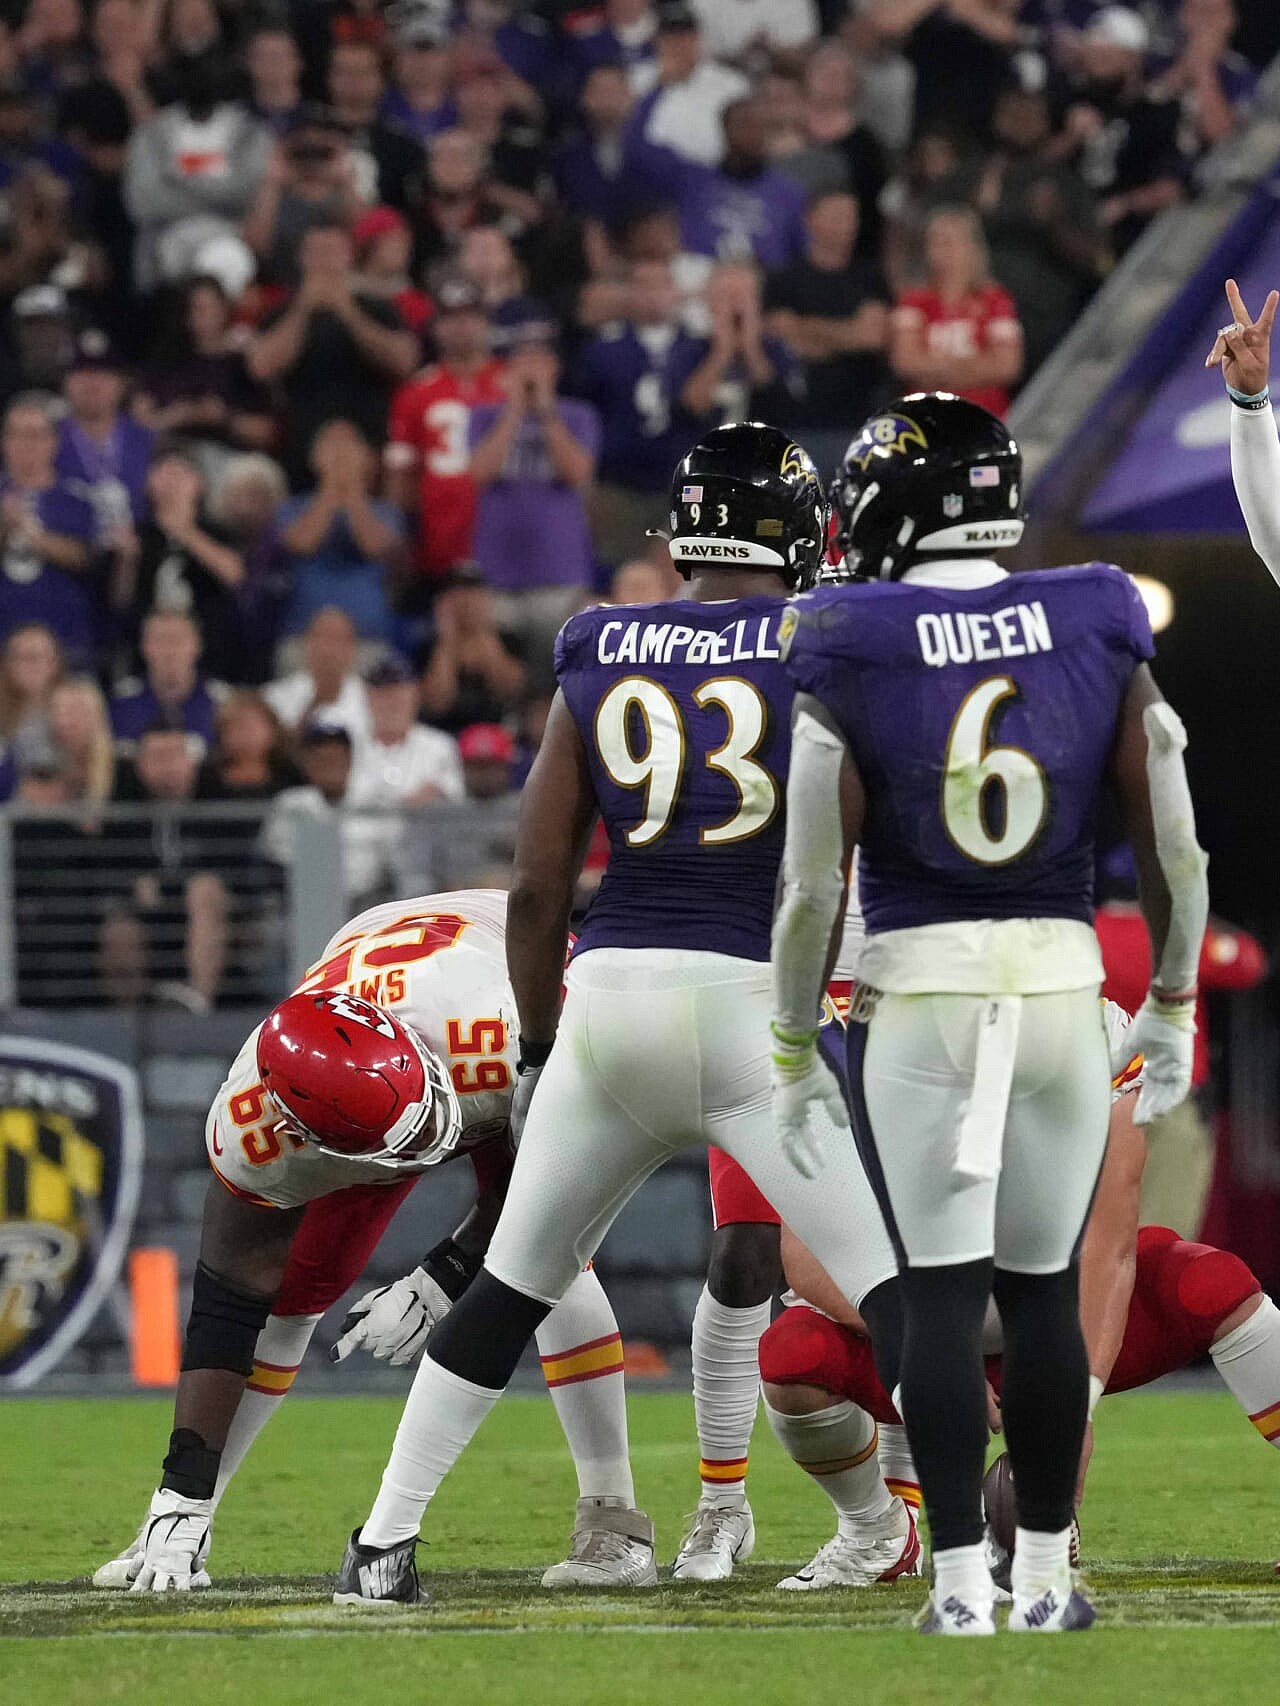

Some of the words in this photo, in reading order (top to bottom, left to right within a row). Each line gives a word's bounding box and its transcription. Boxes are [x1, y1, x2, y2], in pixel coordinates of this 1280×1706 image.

[680, 545, 750, 558] RAVENS
[597, 616, 780, 665] CAMPBELL
[915, 601, 1053, 668] QUEEN
[594, 675, 780, 847] 93
[941, 675, 1048, 867] 6
[445, 1017, 512, 1096] 65
